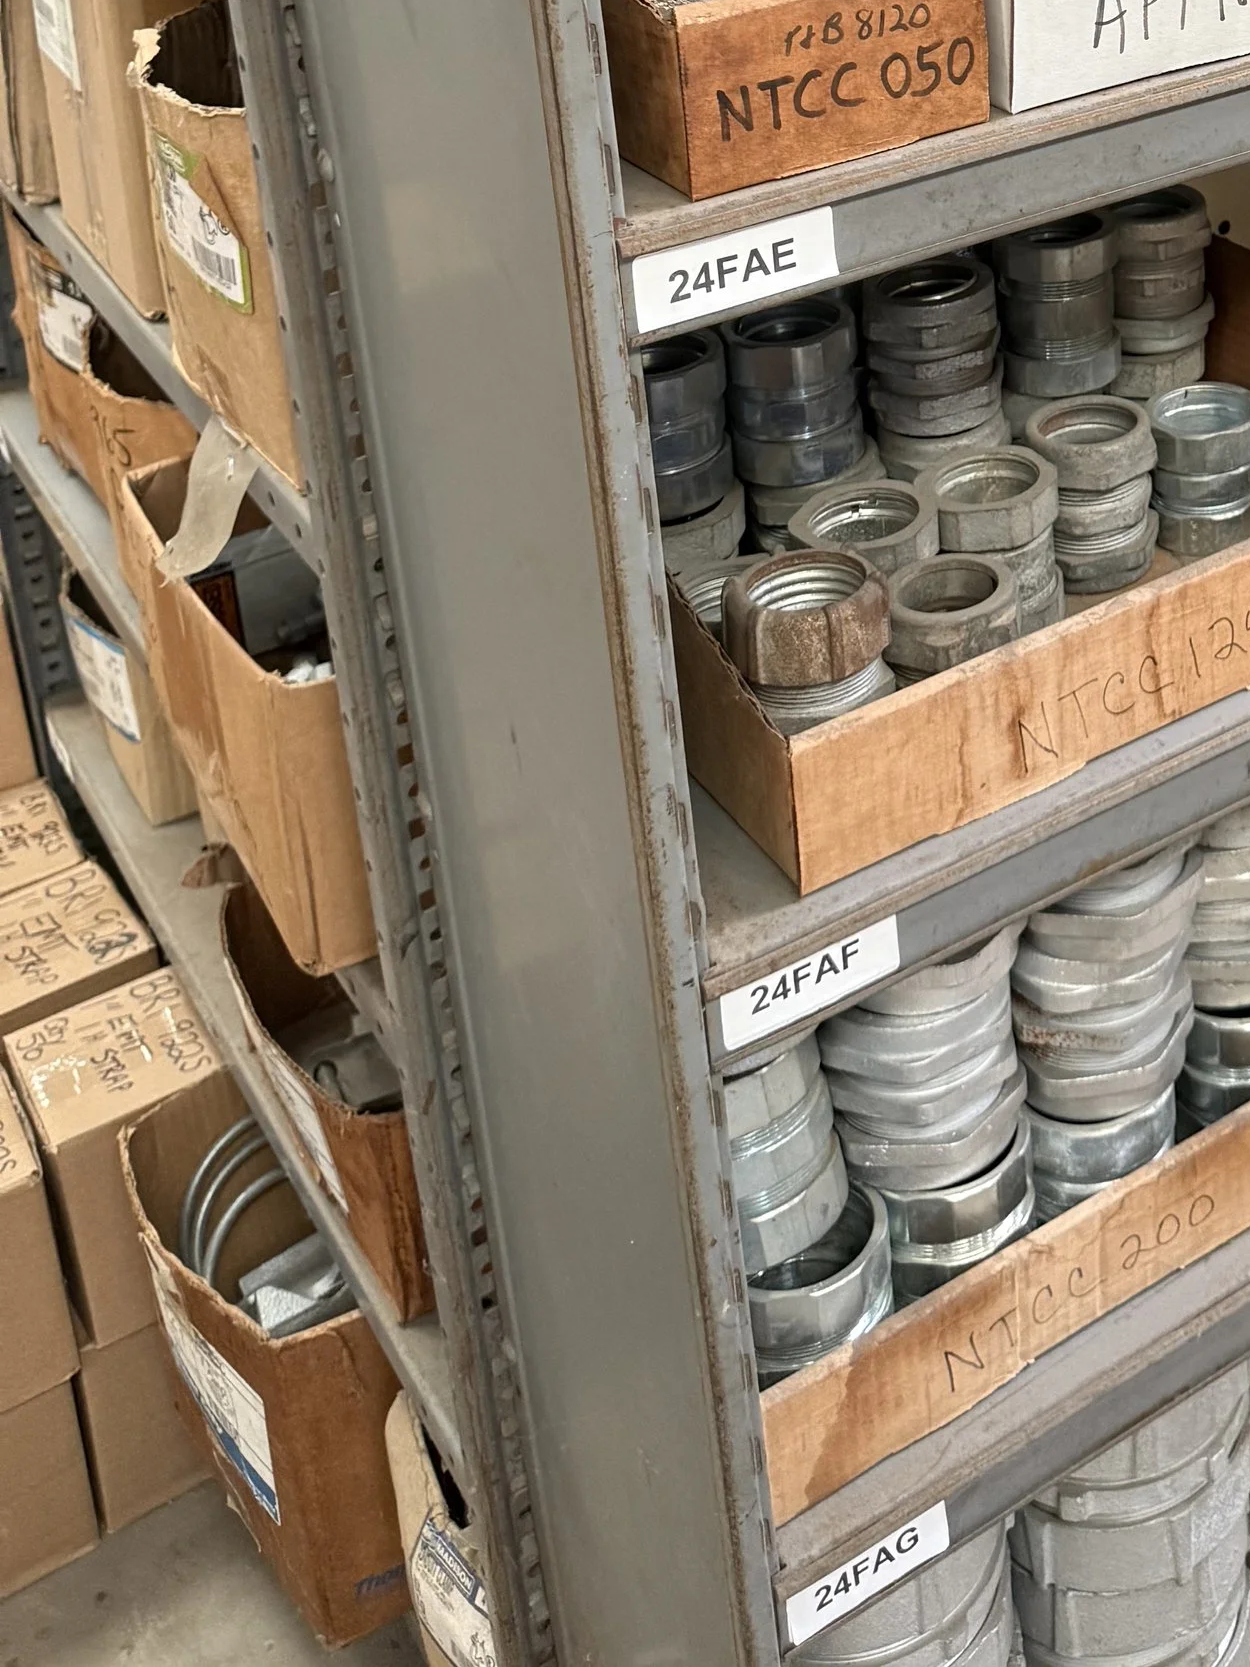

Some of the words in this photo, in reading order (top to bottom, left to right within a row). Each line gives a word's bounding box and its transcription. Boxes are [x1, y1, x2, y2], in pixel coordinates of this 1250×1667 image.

[855, 2, 931, 41] 8120
[667, 237, 797, 305] 24FAE
[750, 938, 860, 1016] 24FAF
[91, 1048, 134, 1092] STRAP
[814, 1526, 919, 1612] 24FAG
